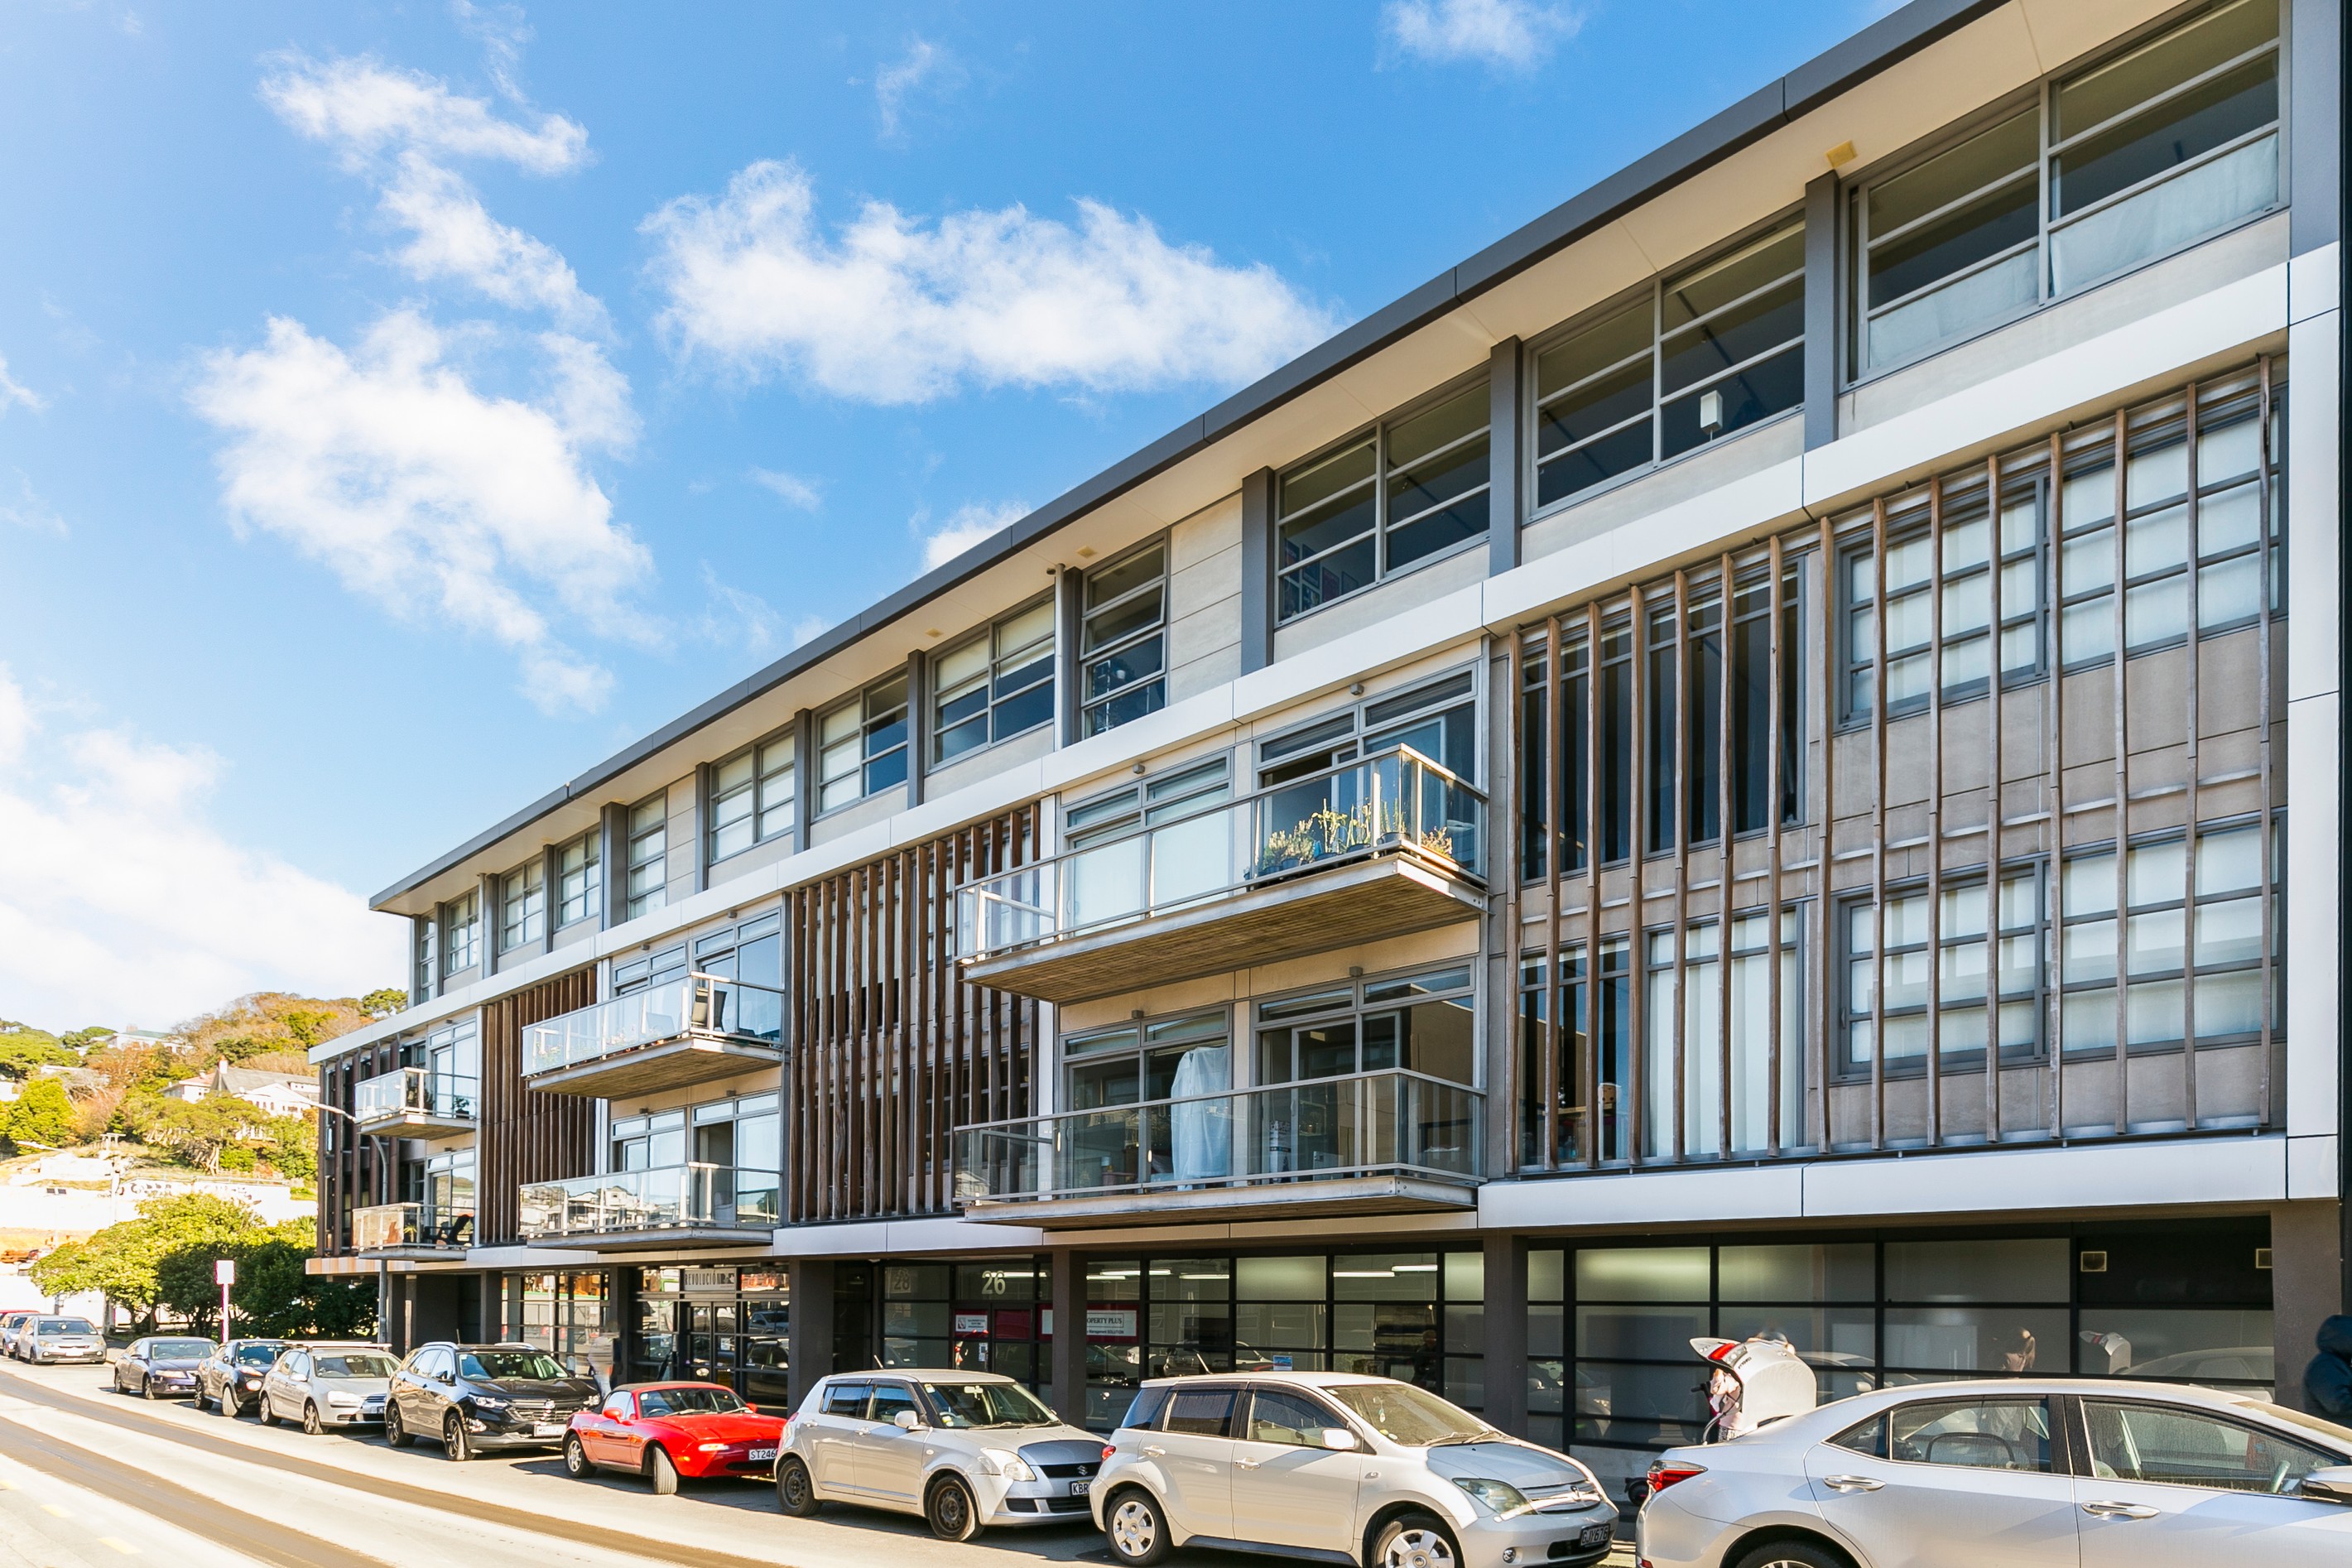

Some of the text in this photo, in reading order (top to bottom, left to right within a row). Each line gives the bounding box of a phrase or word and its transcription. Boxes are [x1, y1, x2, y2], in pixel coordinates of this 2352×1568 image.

[981, 1270, 1006, 1295] 26
[1073, 1483, 1090, 1493] KBR
[1581, 1527, 1608, 1544] GJY676
